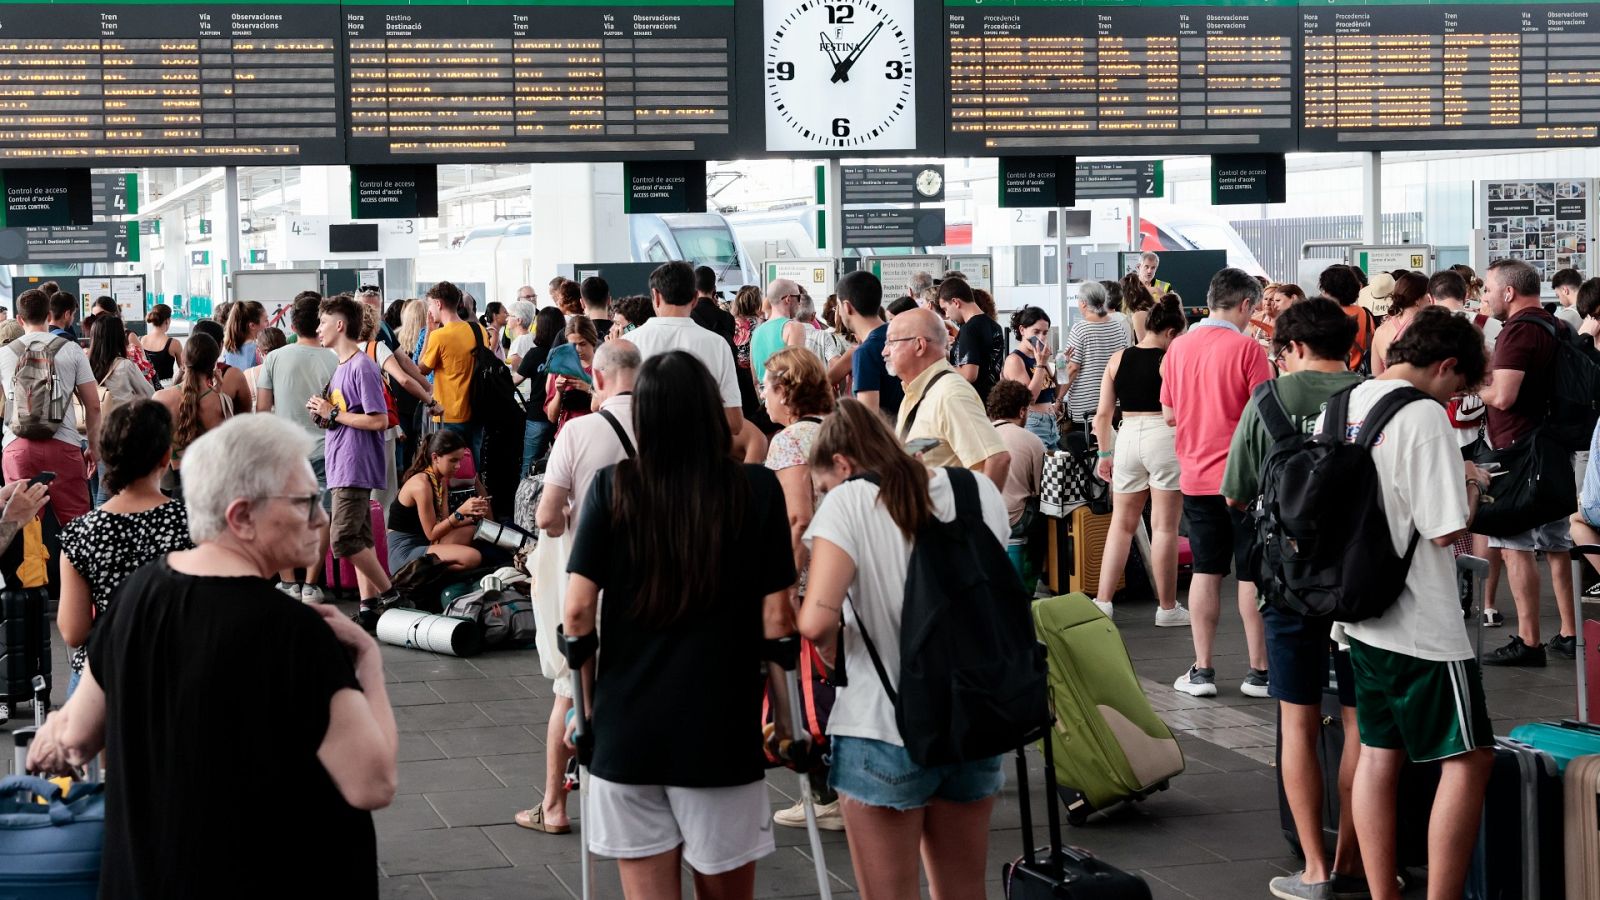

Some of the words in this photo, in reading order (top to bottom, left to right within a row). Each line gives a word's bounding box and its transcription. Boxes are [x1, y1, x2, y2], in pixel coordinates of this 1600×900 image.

[824, 4, 855, 24] 12
[819, 43, 860, 51] FESTINA
[776, 61, 795, 81] 9
[885, 60, 903, 80] 3
[832, 118, 850, 138] 6
[1146, 179, 1154, 194] 2
[113, 194, 126, 210] 4
[1016, 209, 1023, 222] 2
[1114, 207, 1122, 220] 1
[291, 221, 302, 236] 4
[405, 220, 414, 235] 3
[115, 242, 127, 258] 4
